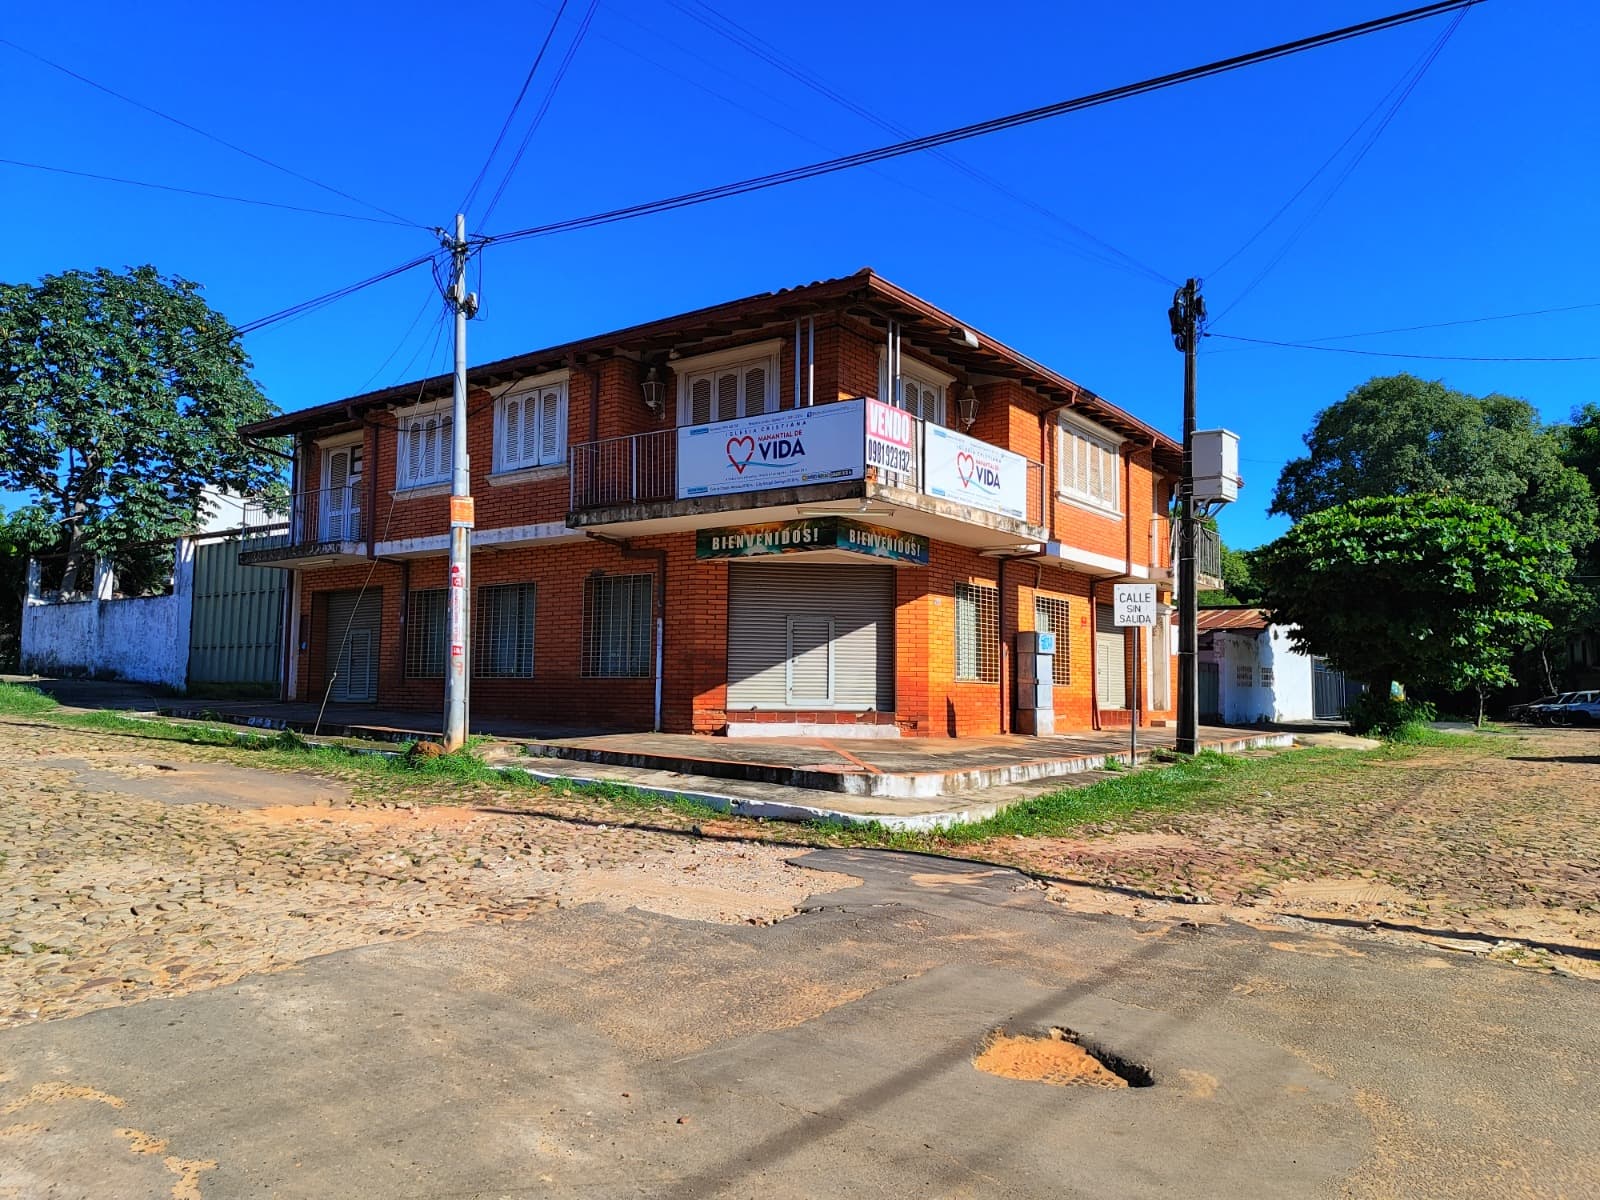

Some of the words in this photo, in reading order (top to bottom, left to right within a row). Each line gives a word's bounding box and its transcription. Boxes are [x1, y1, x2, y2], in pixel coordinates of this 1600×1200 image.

[868, 402, 910, 445] VENDO
[758, 431, 794, 442] MANANTIAL
[794, 429, 803, 438] DE
[758, 438, 806, 461] VIDA
[976, 465, 1001, 490] VIDA
[711, 527, 819, 551] BIENVENIDOS!
[849, 528, 921, 557] BIENVENIDOS!
[1119, 592, 1151, 603] CALLE
[1126, 604, 1141, 613] SIN
[1119, 614, 1152, 624] SALIDA
